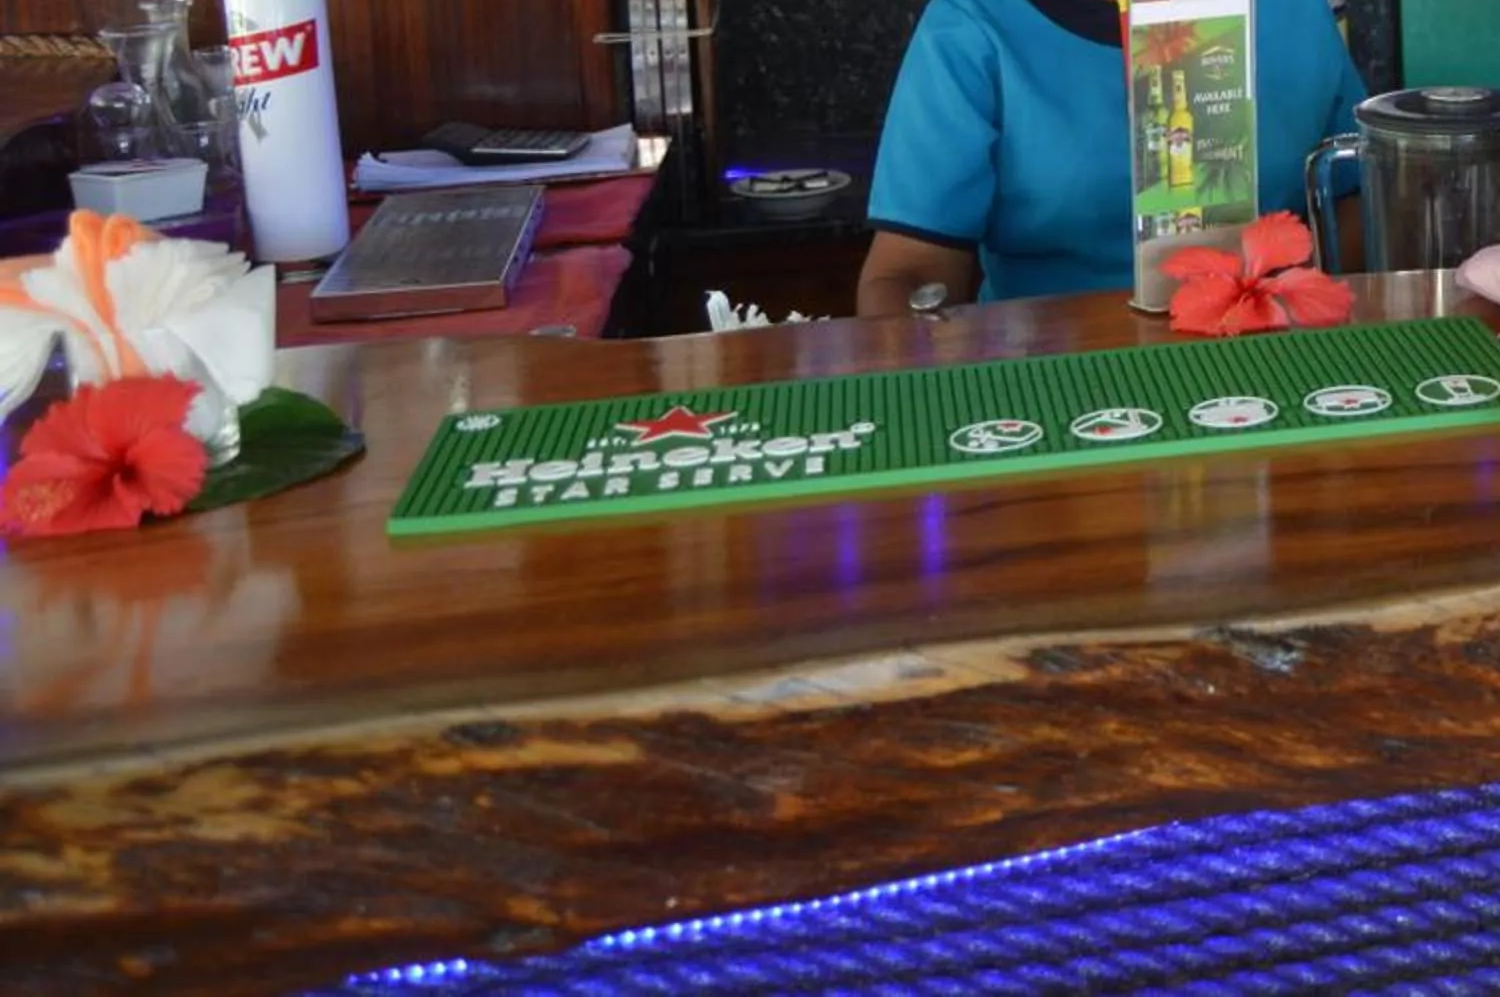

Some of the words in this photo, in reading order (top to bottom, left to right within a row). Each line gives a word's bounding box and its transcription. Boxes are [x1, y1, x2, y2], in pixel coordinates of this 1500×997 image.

[1193, 87, 1244, 104] AVAILABLE
[464, 435, 862, 490] Heineken
[494, 477, 631, 507] STAR
[657, 456, 826, 490] SERVE
